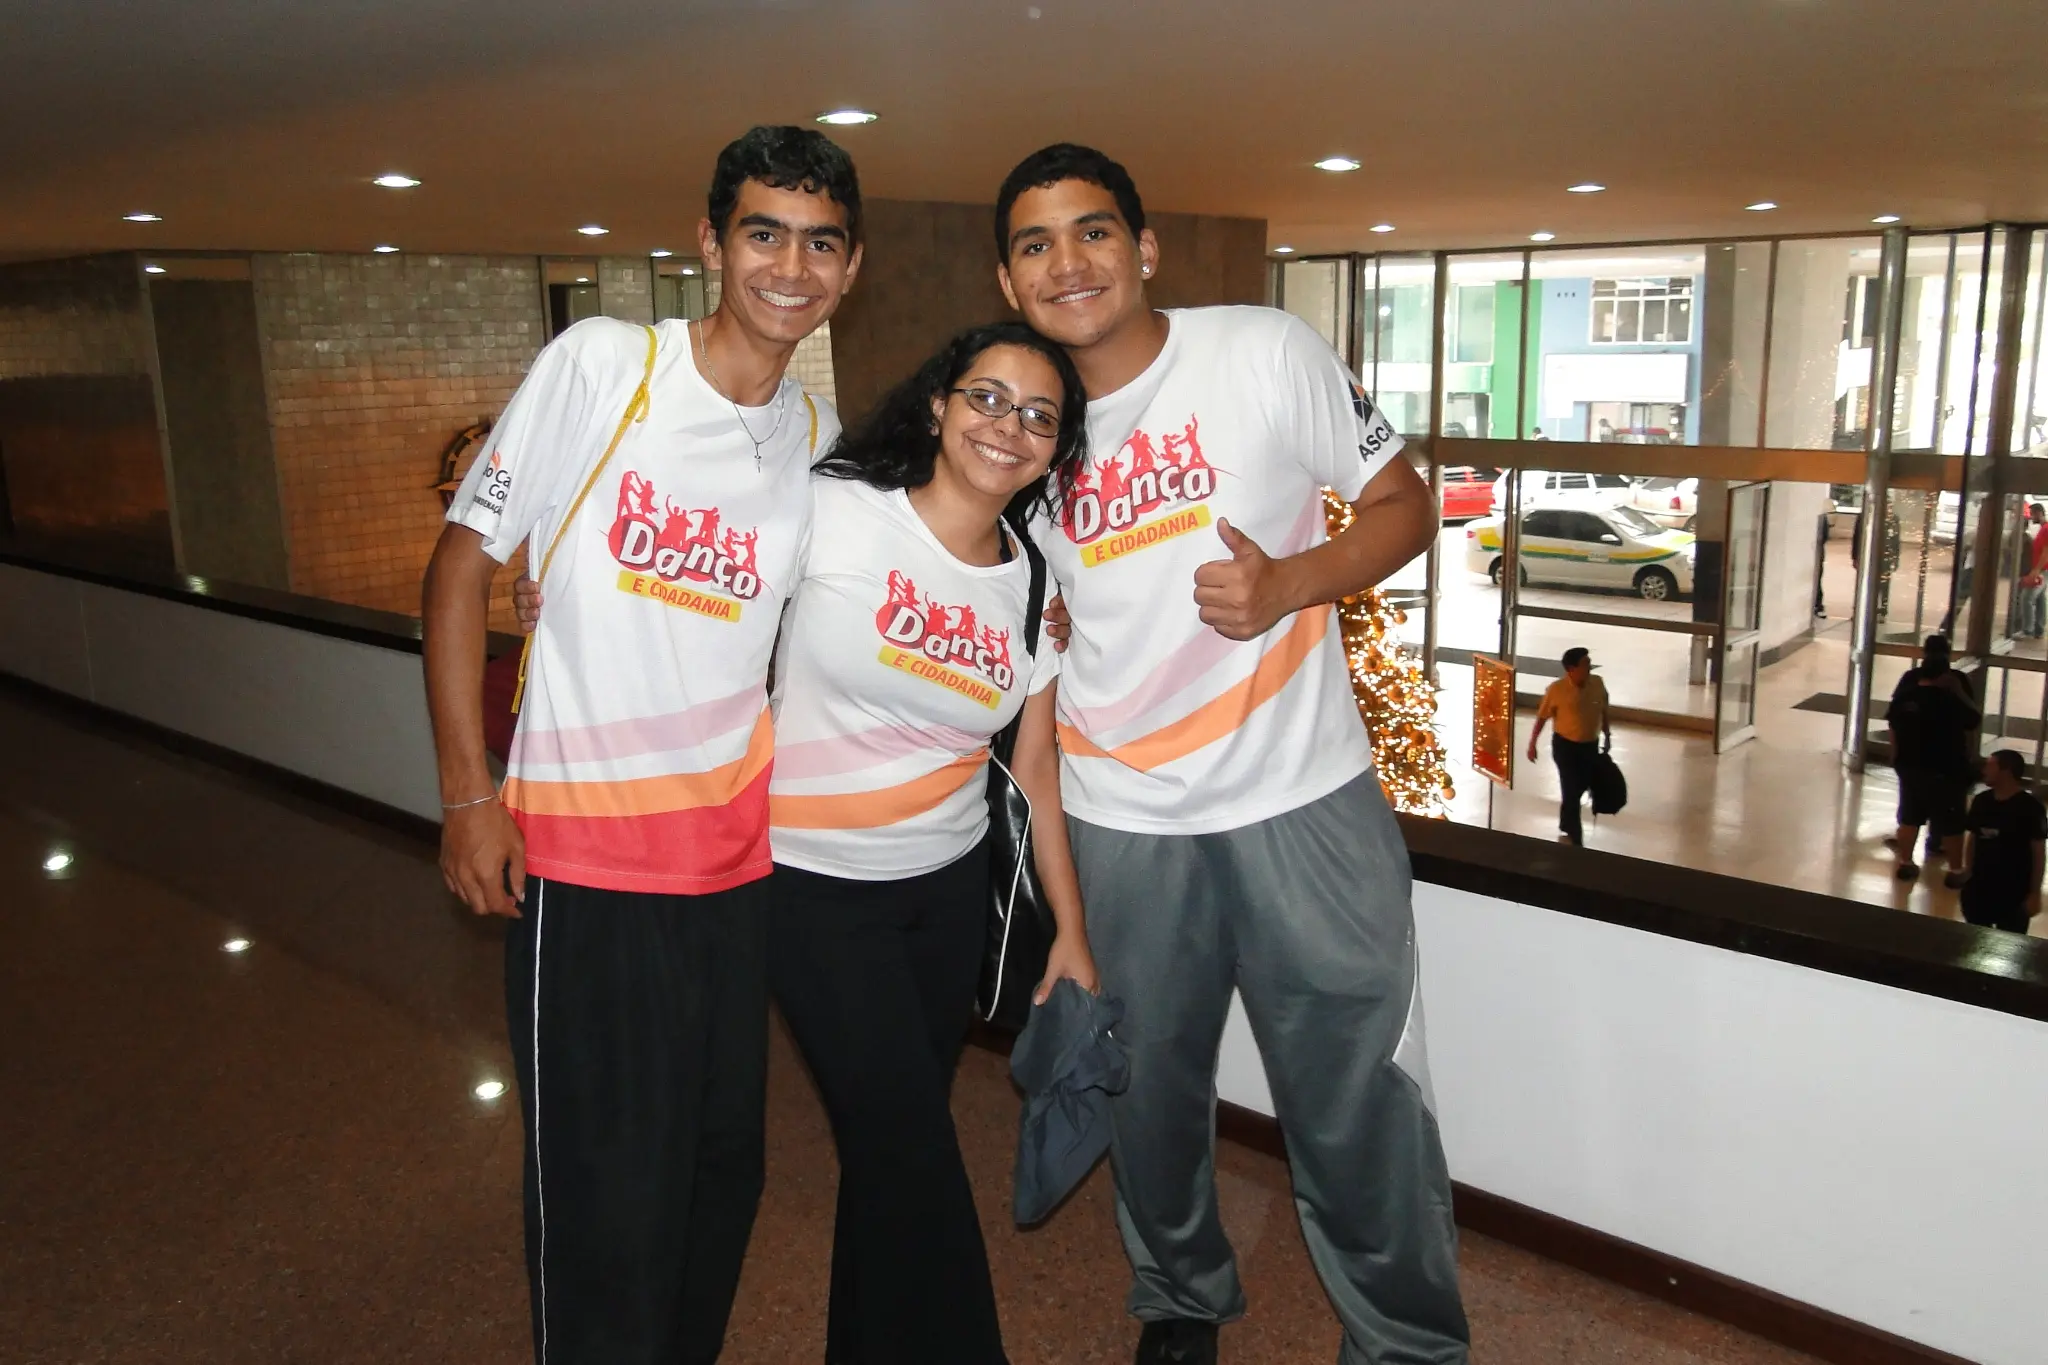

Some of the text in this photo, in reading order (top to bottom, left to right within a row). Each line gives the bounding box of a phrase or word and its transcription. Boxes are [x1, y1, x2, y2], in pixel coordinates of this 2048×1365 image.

[1074, 465, 1211, 541] Dança
[619, 520, 756, 597] Dança
[1095, 512, 1198, 562] E CIDADANIA
[632, 579, 645, 593] E
[885, 606, 1011, 690] Dança
[893, 654, 992, 704] E CIDADANIA
